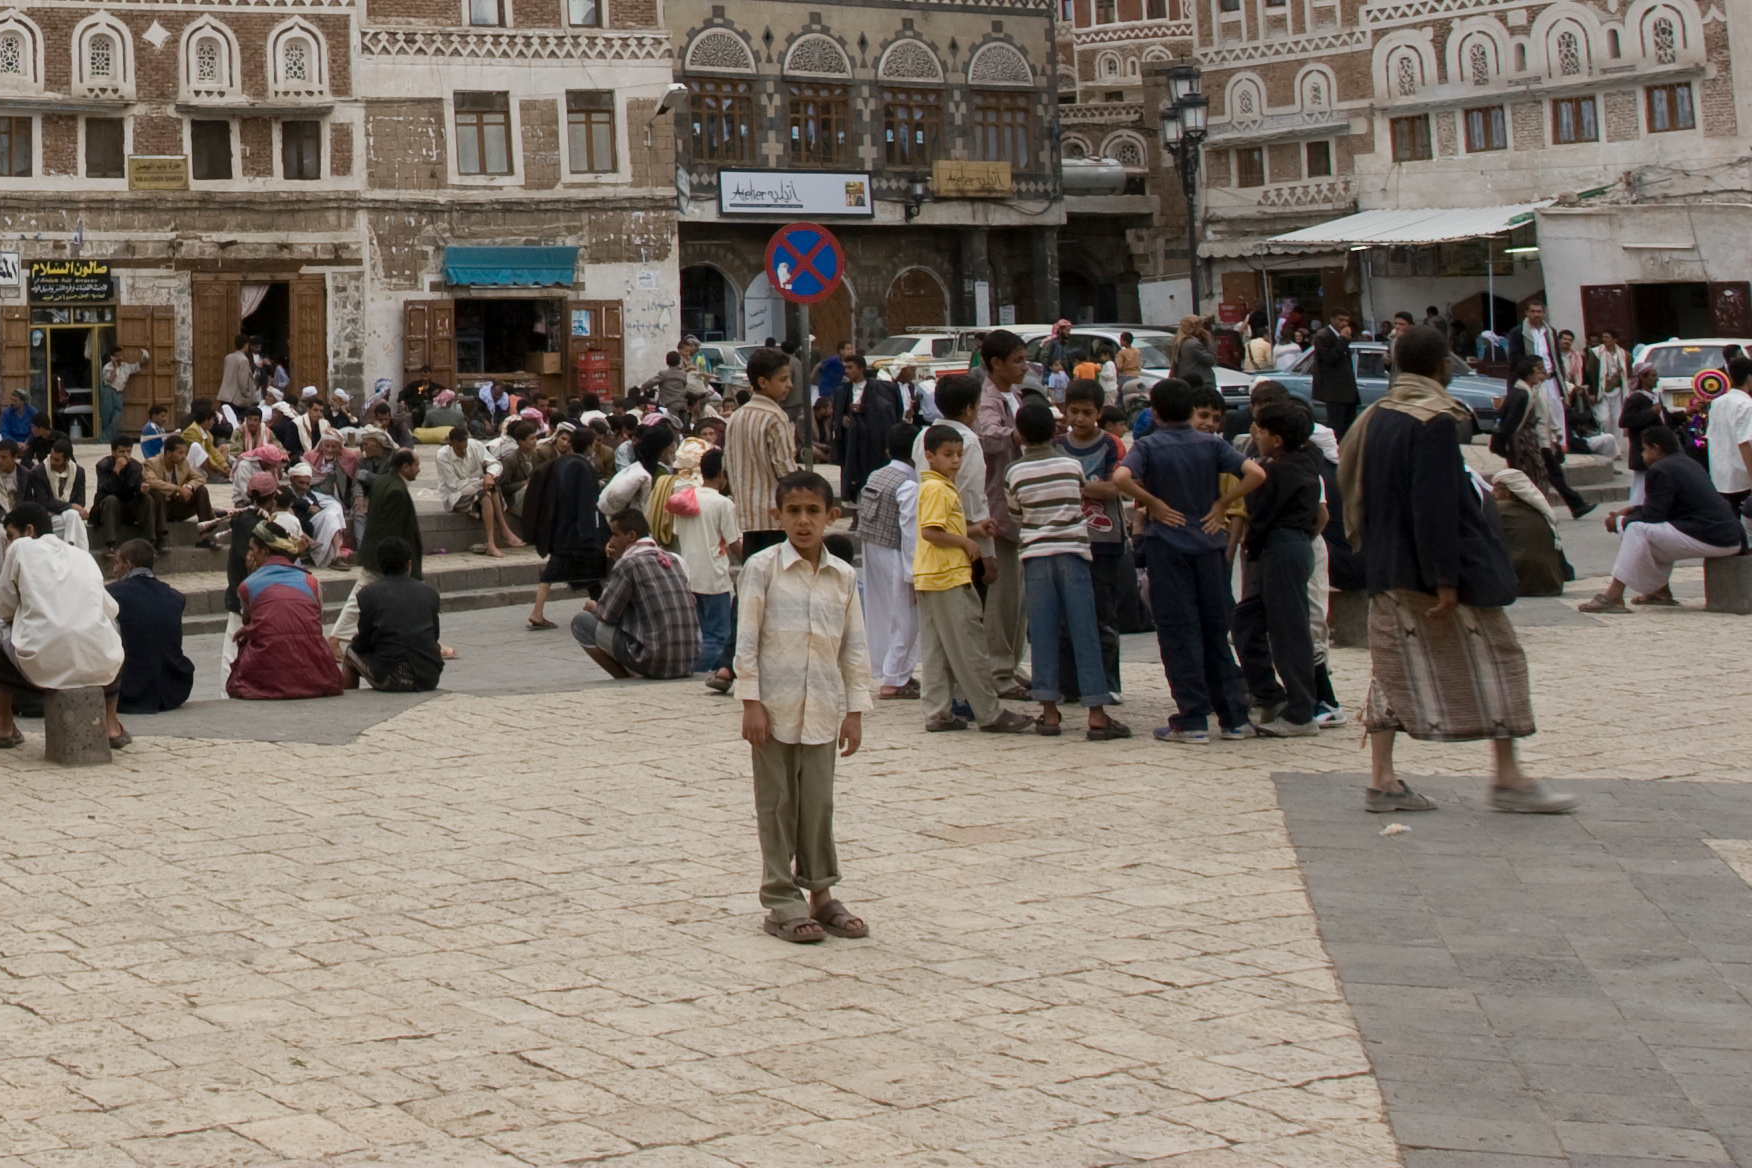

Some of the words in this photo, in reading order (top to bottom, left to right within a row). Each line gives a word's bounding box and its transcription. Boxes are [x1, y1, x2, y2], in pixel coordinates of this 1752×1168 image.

[731, 178, 766, 202] Atelier
[32, 260, 74, 279] السلام
[73, 260, 108, 277] صالون
